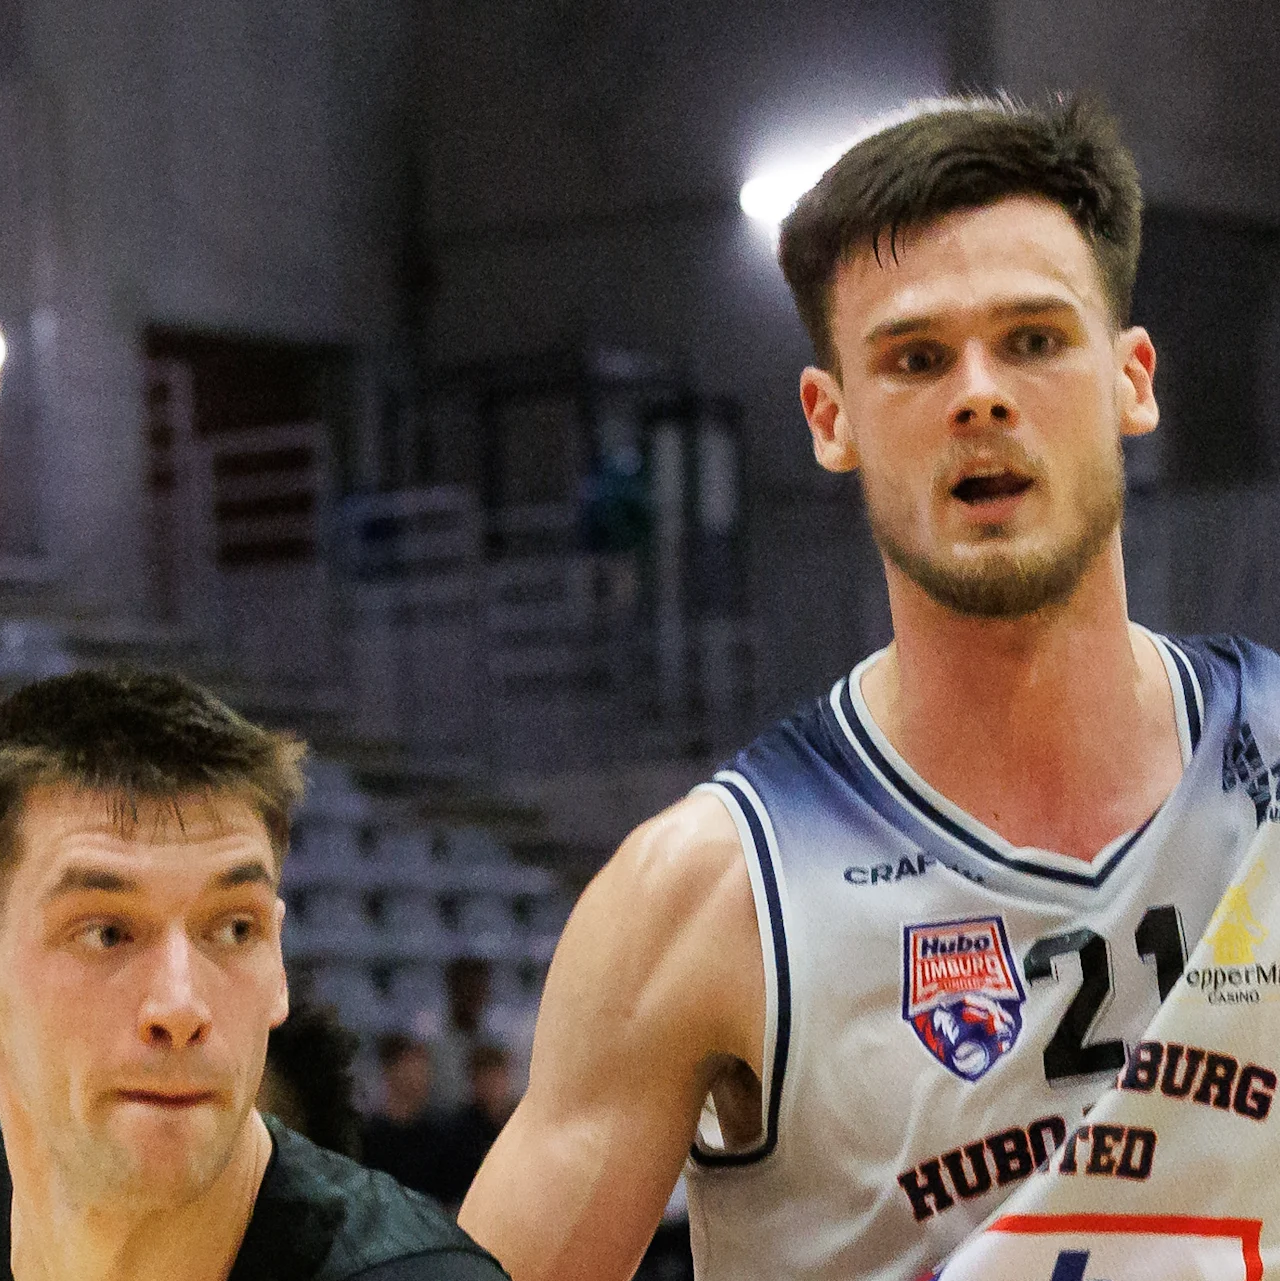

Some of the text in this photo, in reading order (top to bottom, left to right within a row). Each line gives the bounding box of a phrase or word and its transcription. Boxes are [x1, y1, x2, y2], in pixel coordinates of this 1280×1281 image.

[921, 934, 992, 957] Hubo
[1025, 903, 1188, 1088] 21
[1118, 1040, 1278, 1122] BURG
